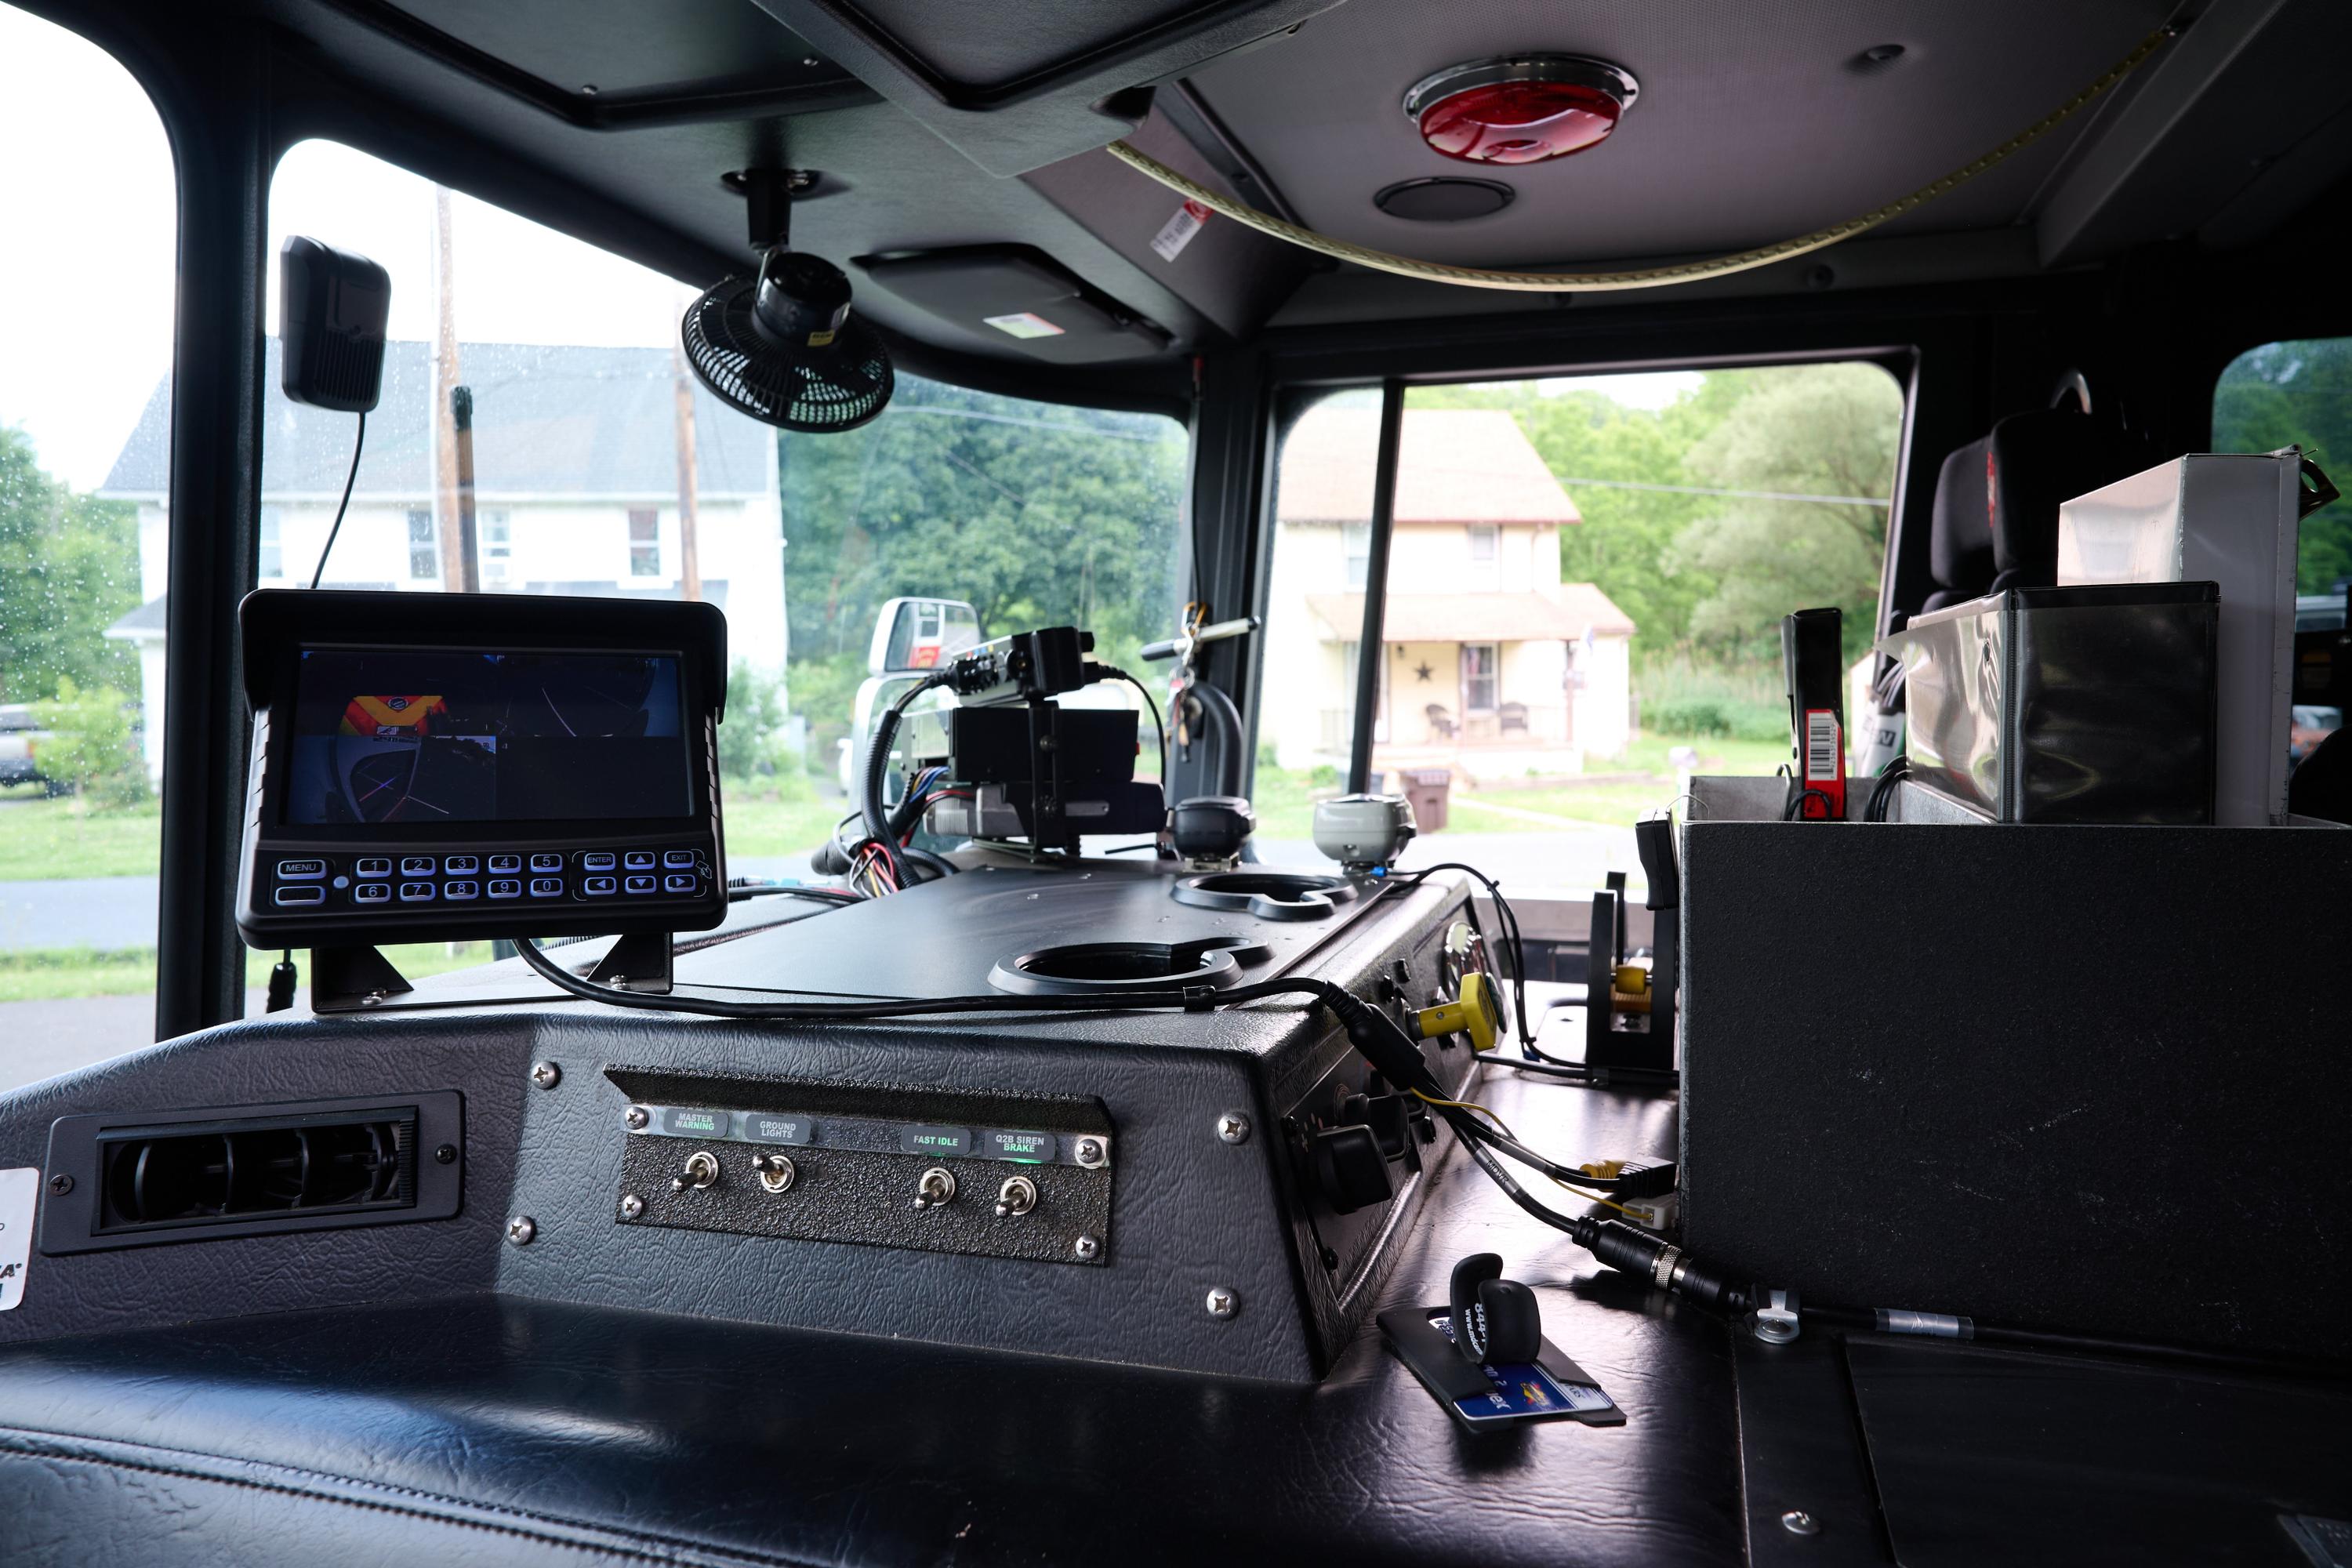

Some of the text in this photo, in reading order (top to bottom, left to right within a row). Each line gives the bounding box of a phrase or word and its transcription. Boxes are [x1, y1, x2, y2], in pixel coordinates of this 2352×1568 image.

[413, 860, 423, 870] 2
[457, 858, 466, 869] 3
[500, 857, 509, 868] 4
[543, 856, 551, 866] 5
[588, 855, 612, 864] ENTER
[285, 863, 317, 873] MENU
[371, 861, 378, 871] 1
[368, 886, 378, 897] 6
[413, 885, 423, 895] 7
[457, 884, 466, 895] 8
[500, 882, 509, 893] 9
[678, 1112, 713, 1123] MASTER
[674, 1120, 715, 1131] WARNING
[759, 1120, 797, 1131] GROUND
[760, 1129, 793, 1138] LIGHTS
[913, 1134, 958, 1146] FAST IDLE
[996, 1134, 1044, 1145] Q2B SIREN
[1004, 1143, 1036, 1152] BRAKE
[1486, 1160, 1510, 1185] MDVR
